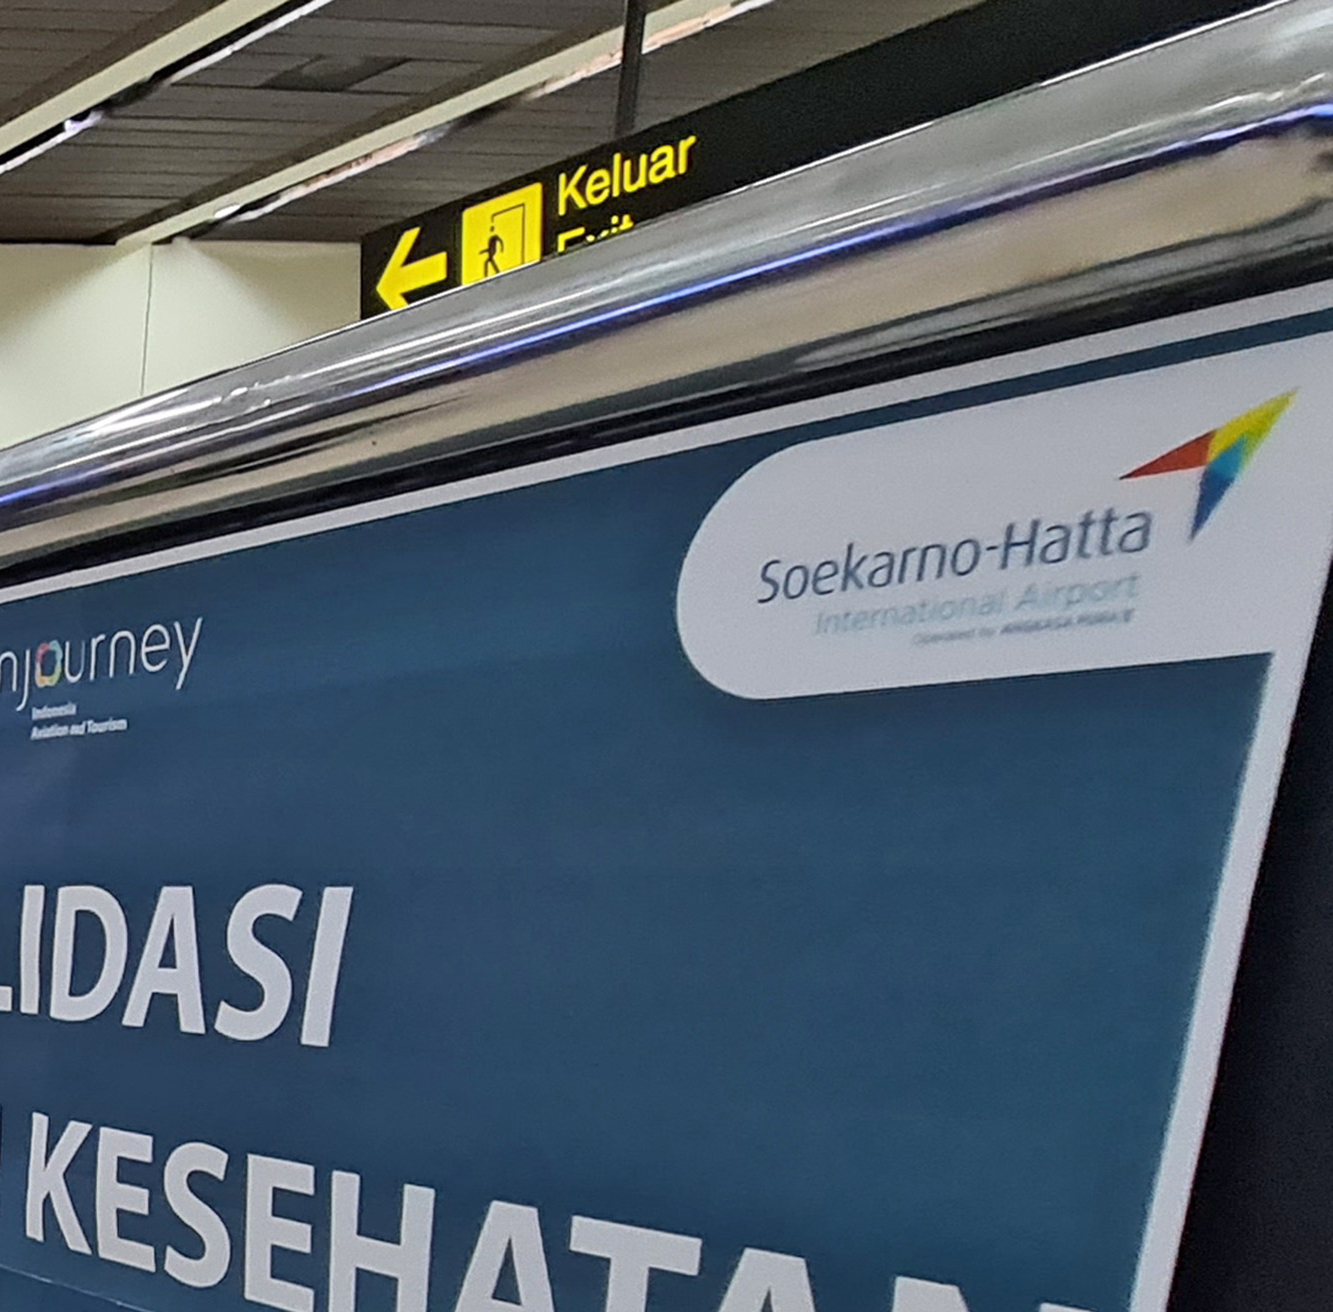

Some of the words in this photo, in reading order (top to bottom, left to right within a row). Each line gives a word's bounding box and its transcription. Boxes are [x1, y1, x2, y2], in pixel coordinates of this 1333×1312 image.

[557, 135, 698, 217] Keluar
[757, 508, 1153, 604] Soekarno-Hatta
[815, 592, 1005, 636] International
[1014, 575, 1140, 615] Airport
[87, 716, 128, 734] Tourism
